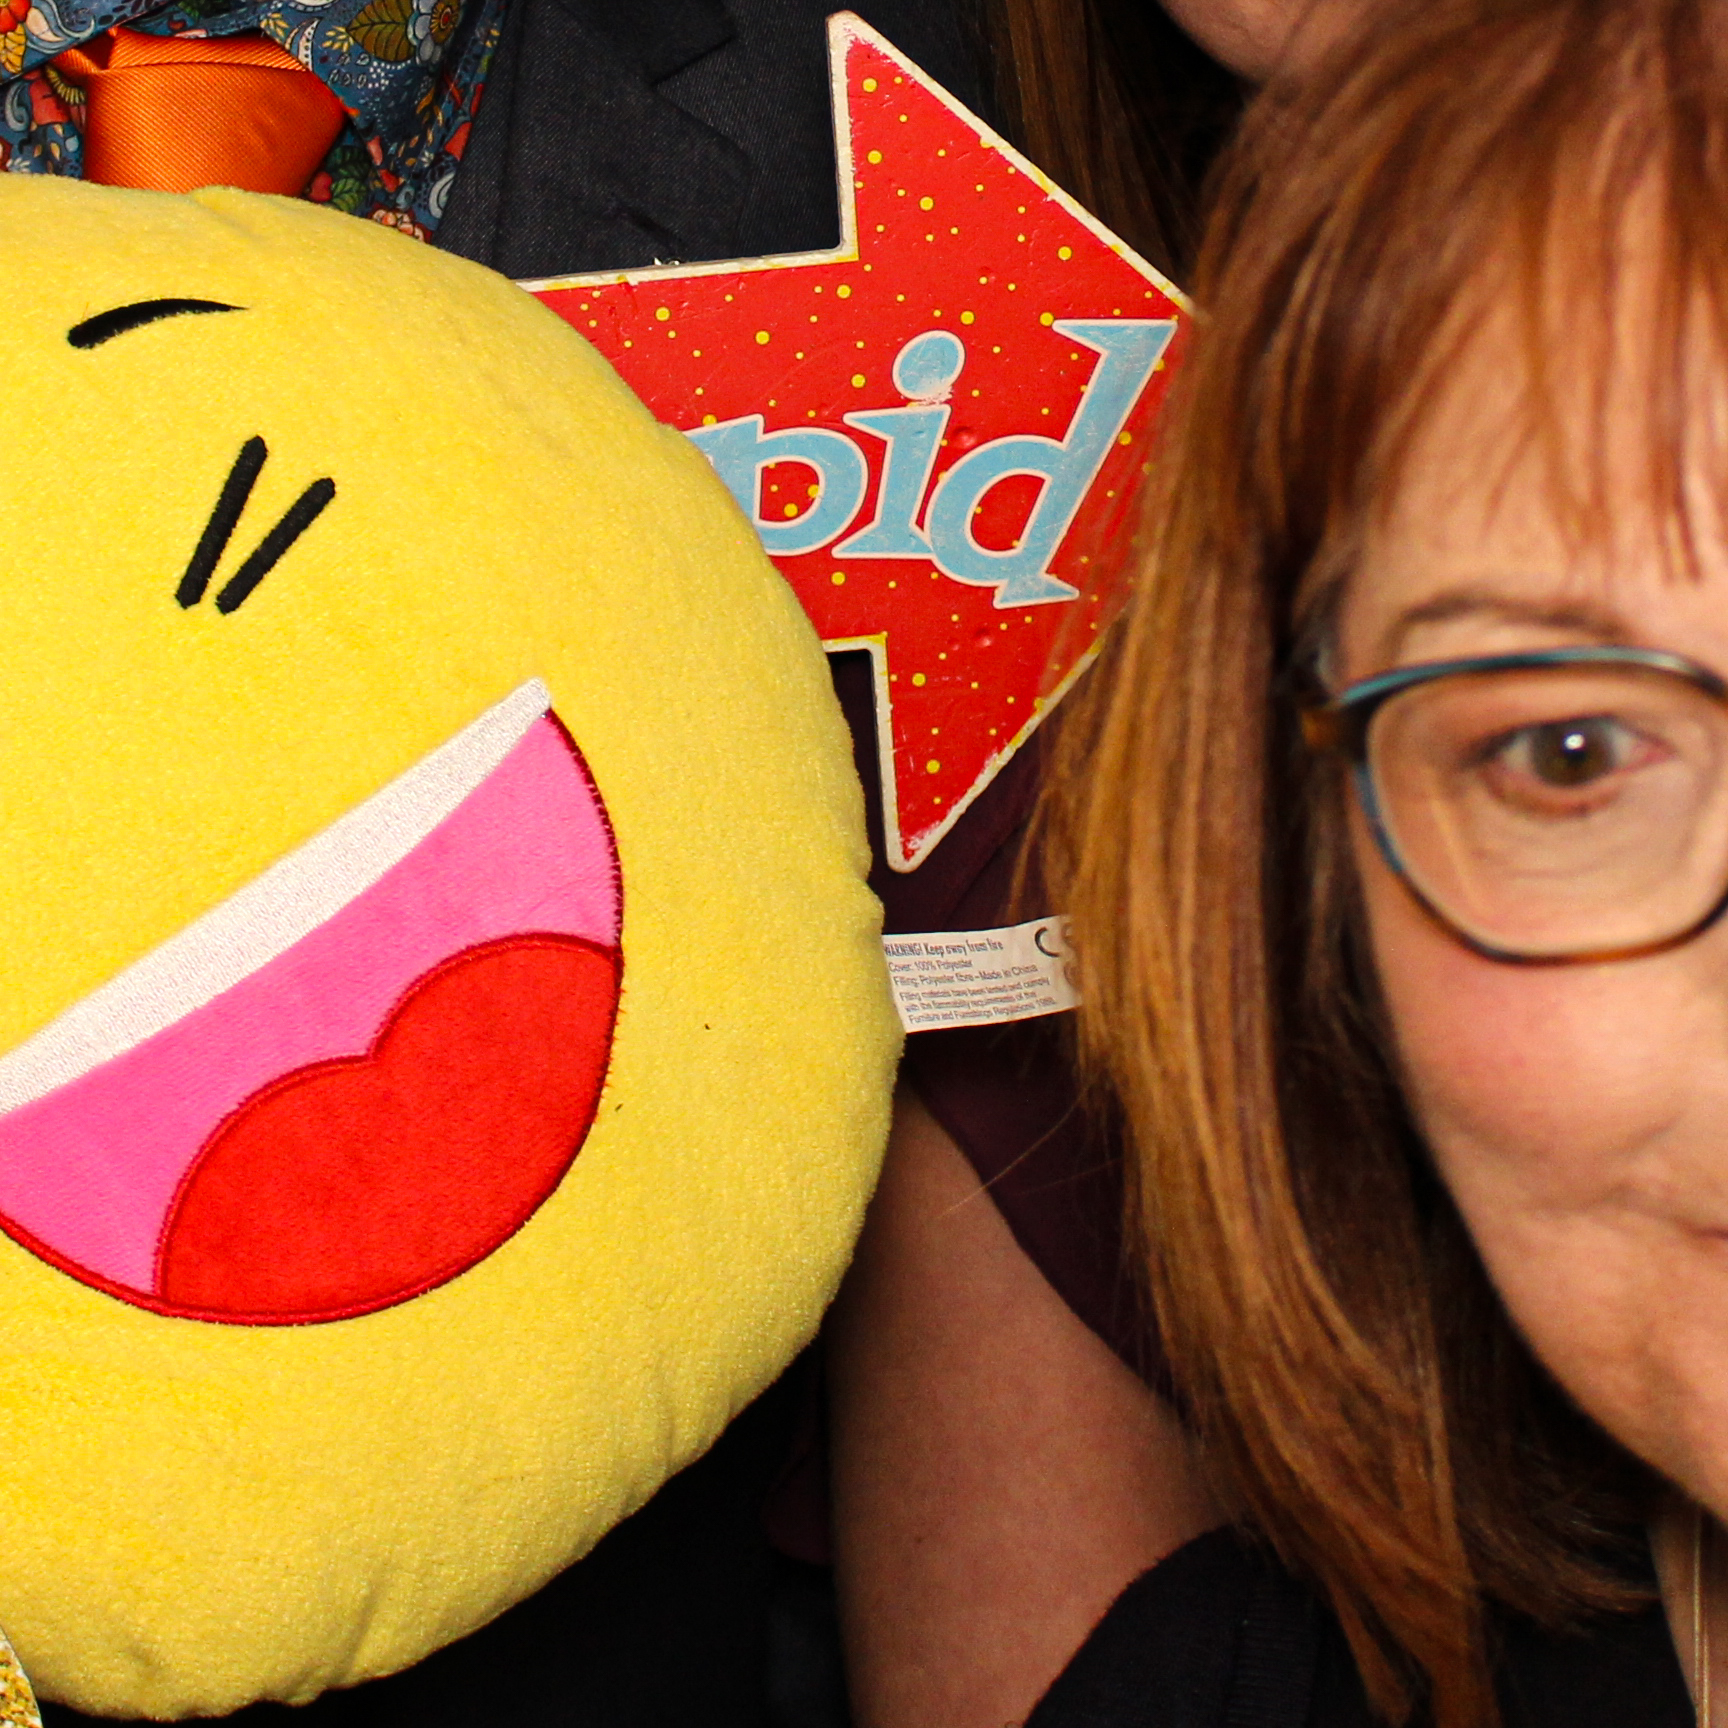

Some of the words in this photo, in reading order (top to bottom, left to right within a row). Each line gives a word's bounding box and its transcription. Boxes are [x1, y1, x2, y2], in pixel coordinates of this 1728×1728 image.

[680, 318, 1178, 609] pid
[924, 943, 944, 957] Keep
[946, 944, 967, 955] away
[967, 940, 987, 952] from
[987, 938, 1003, 950] fire
[915, 961, 935, 971] 100%
[936, 959, 972, 971] Polyester
[920, 974, 954, 986] Polyester
[956, 973, 974, 982] fibre
[1012, 965, 1038, 975] China
